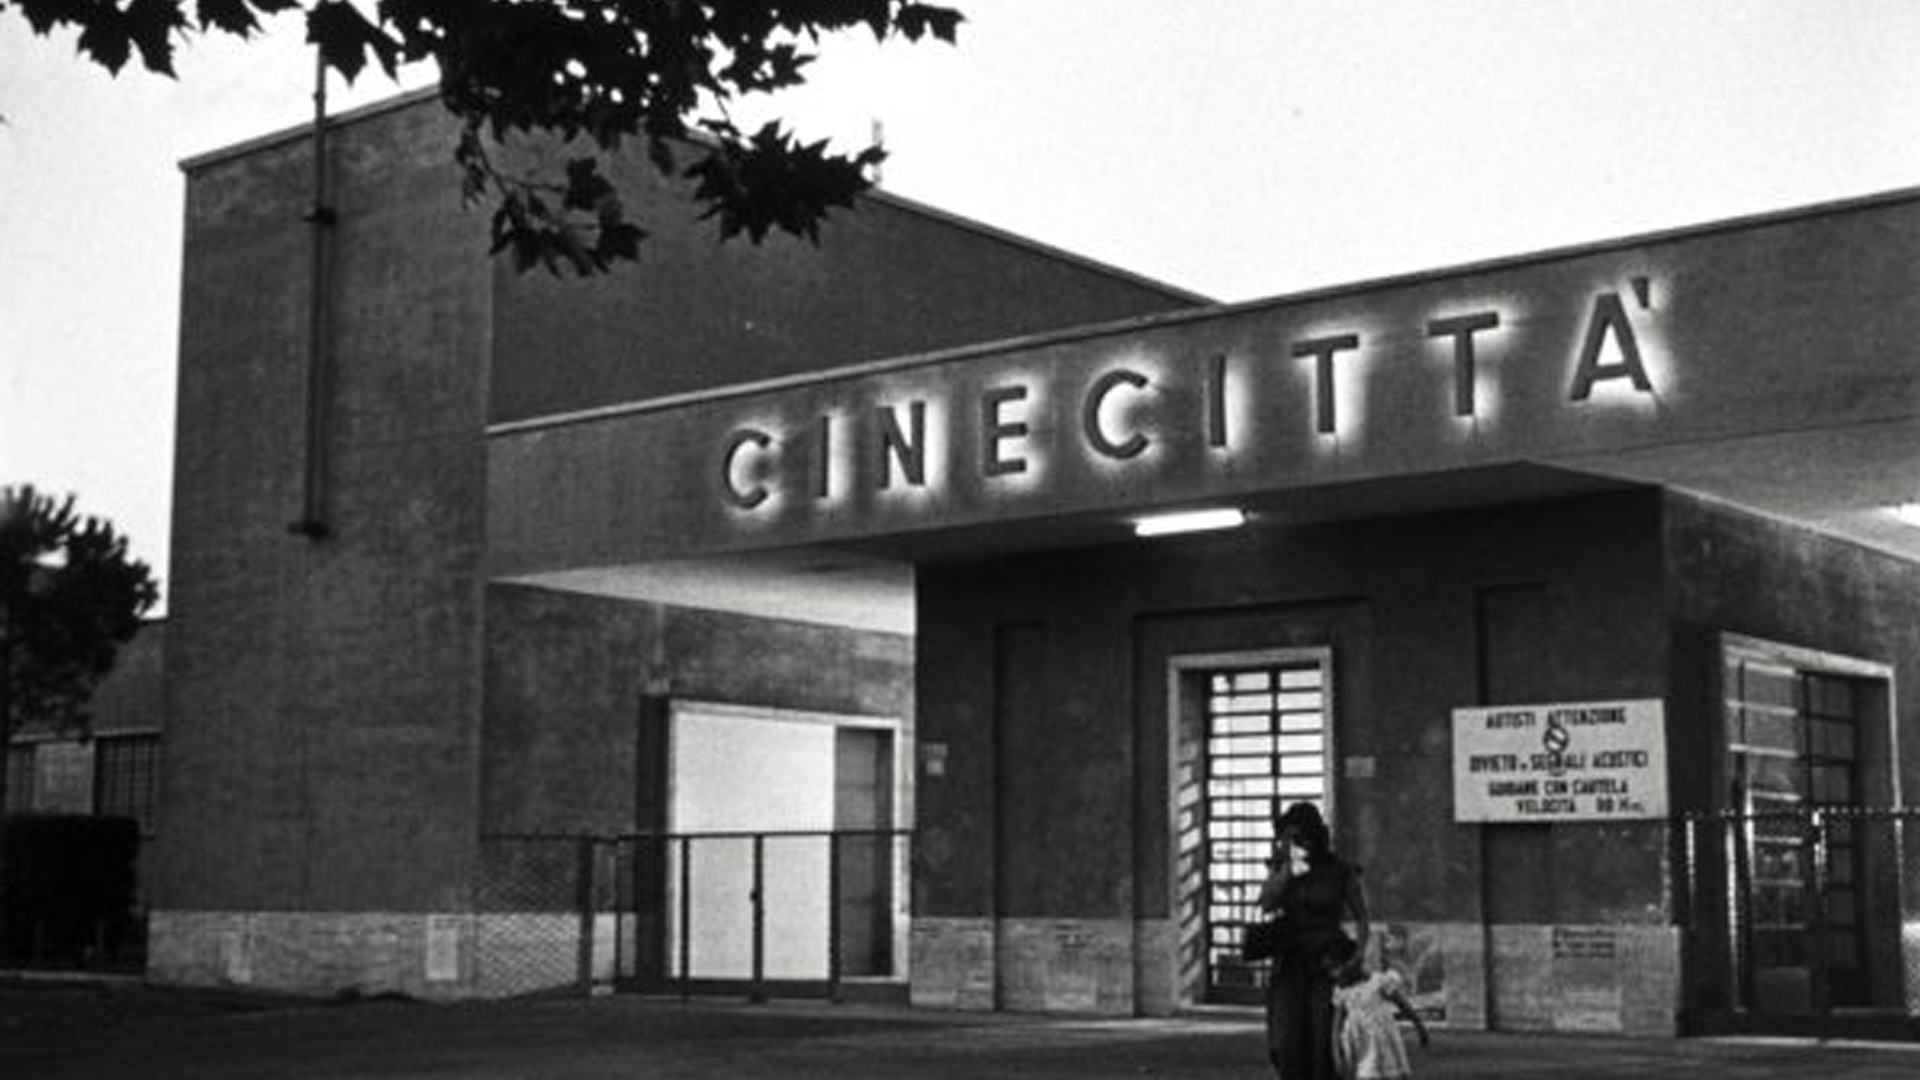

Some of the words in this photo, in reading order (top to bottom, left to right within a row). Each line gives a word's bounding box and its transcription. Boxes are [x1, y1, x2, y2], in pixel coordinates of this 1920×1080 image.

[1547, 707, 1627, 726] ATTENZIONE
[1545, 780, 1568, 795] CON
[1573, 779, 1628, 795] CAUTELA
